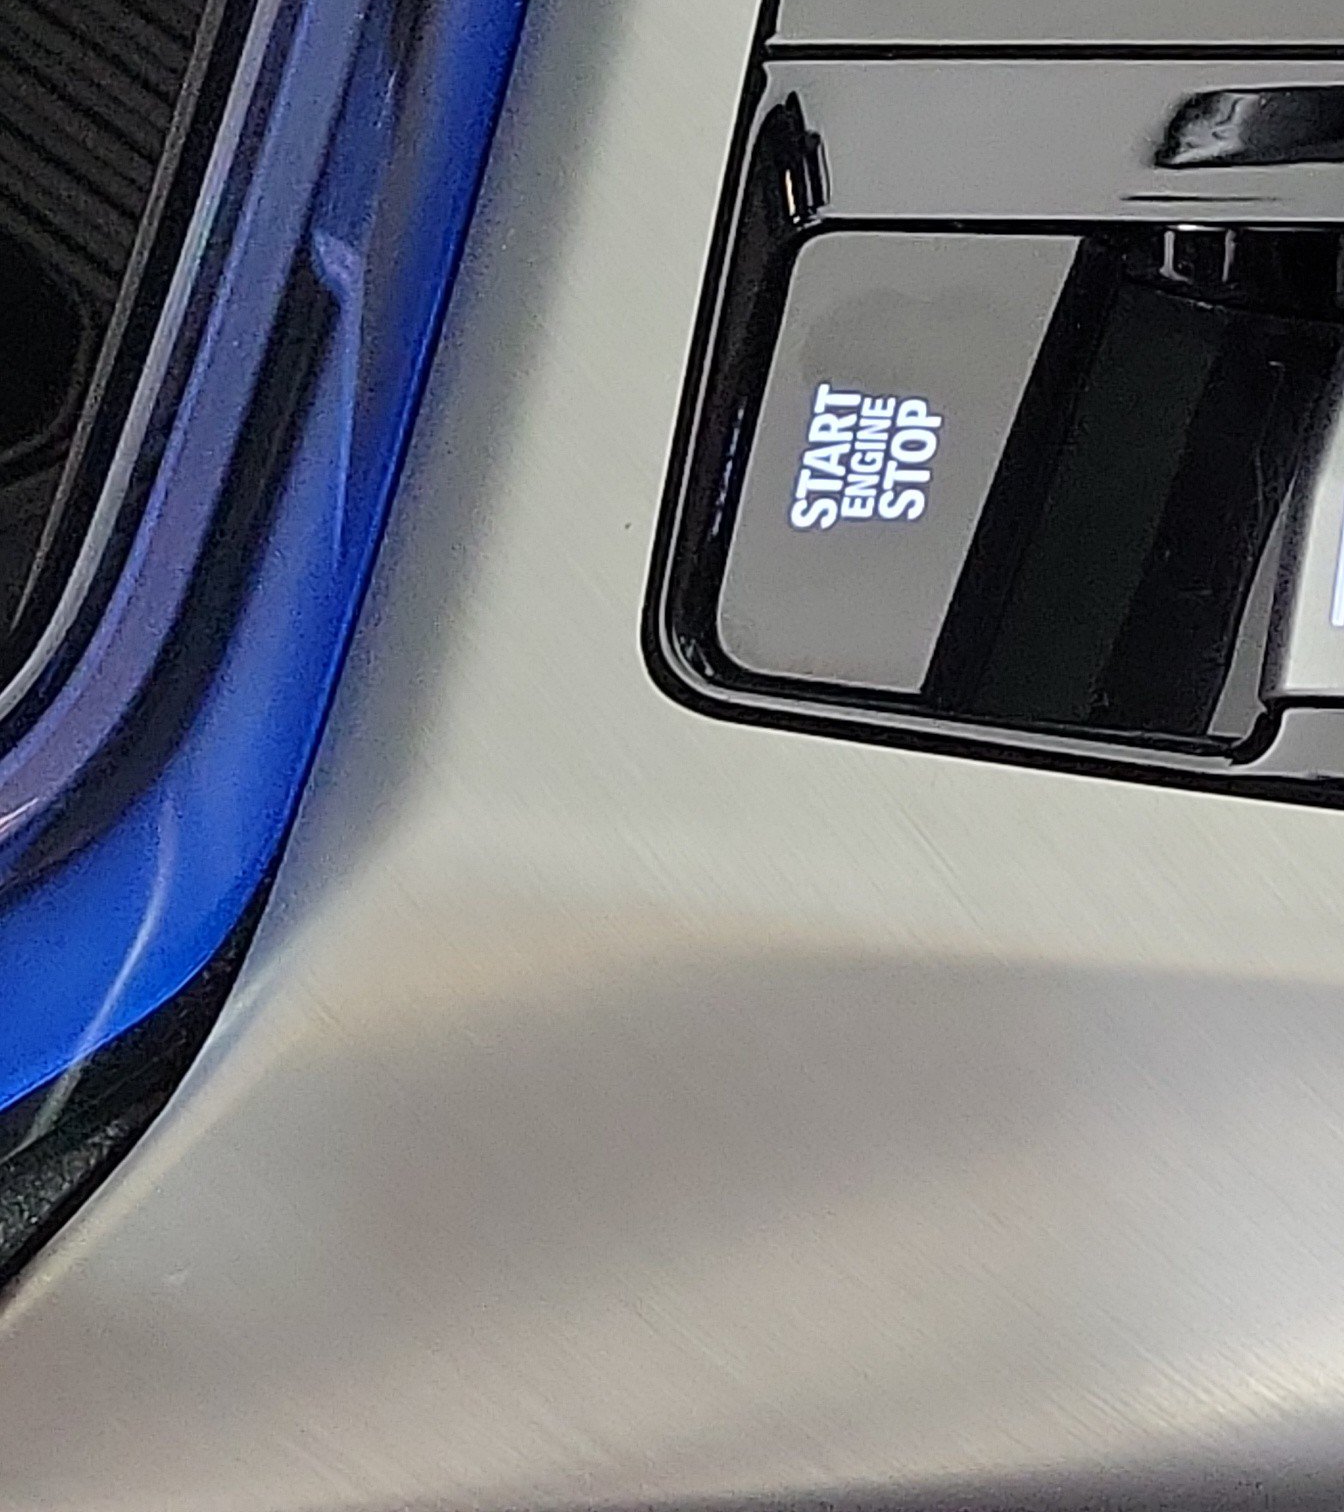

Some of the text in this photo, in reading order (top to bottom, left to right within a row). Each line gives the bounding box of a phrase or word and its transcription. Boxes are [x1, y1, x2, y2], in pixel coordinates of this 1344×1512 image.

[791, 384, 861, 529] START
[840, 397, 896, 518] ENGINE
[878, 399, 942, 520] STOP
